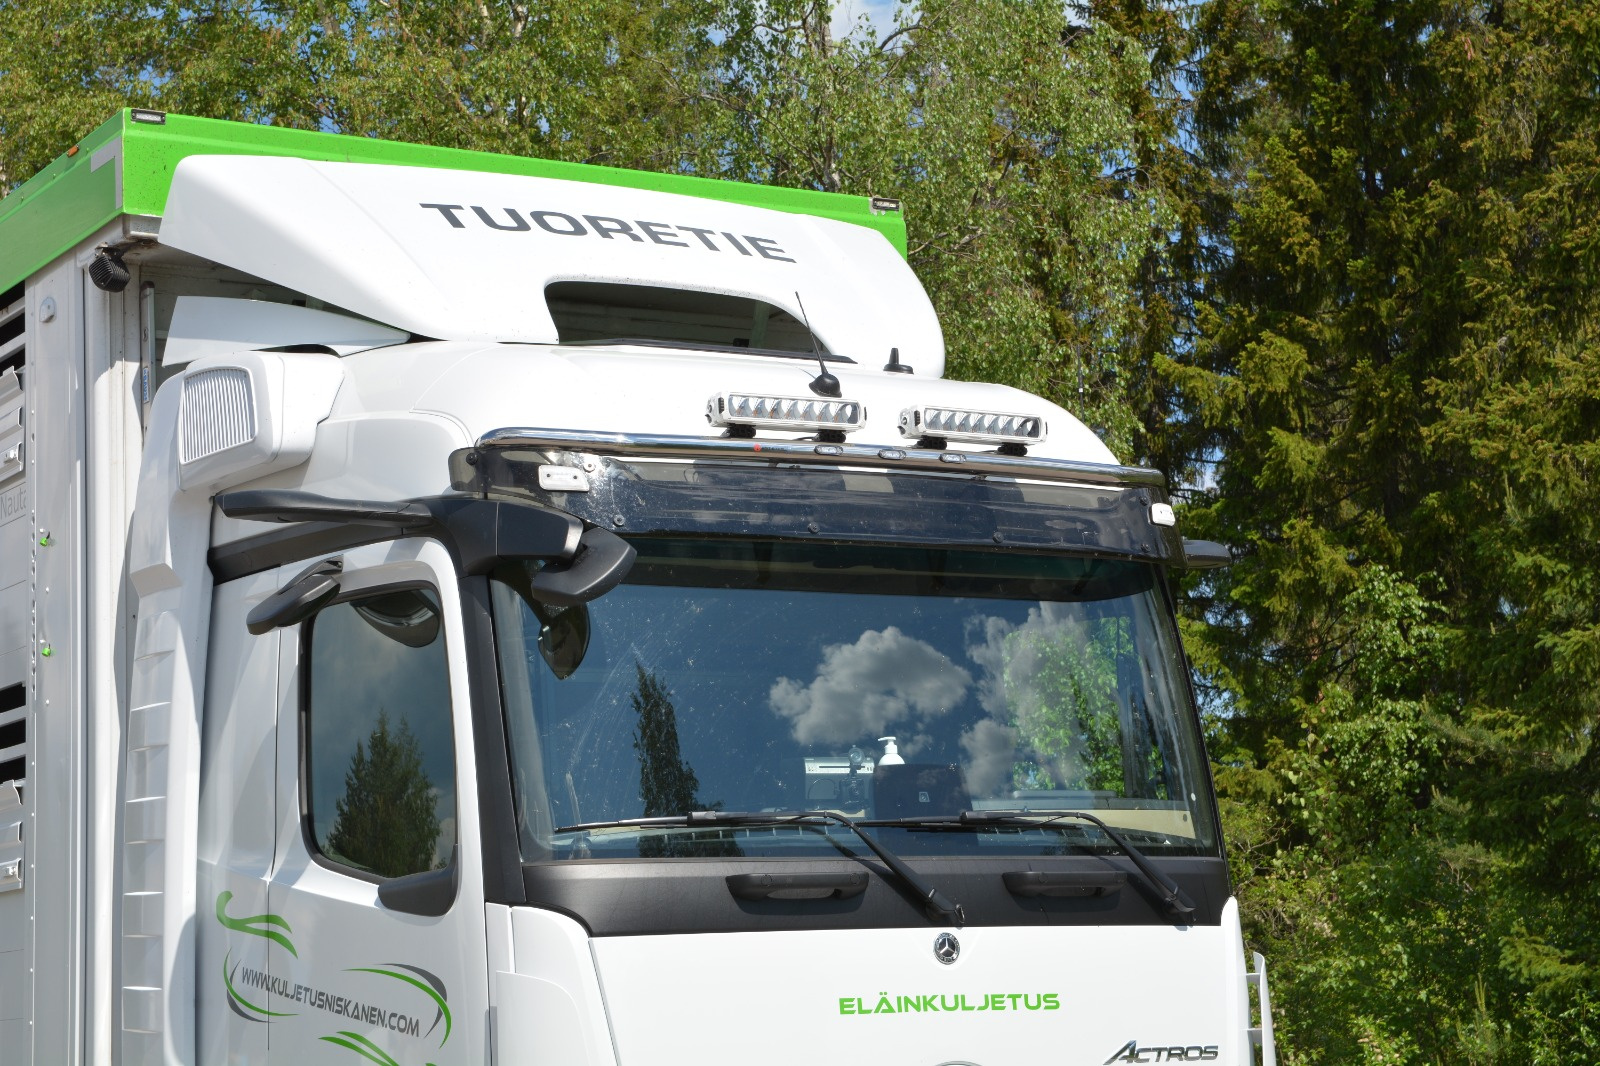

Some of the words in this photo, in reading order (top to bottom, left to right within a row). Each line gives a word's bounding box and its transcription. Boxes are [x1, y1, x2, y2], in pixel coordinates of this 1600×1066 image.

[419, 203, 796, 263] TUORETIE
[241, 966, 420, 1038] WWW.KULJETUSNISKANEN.COM
[839, 991, 1061, 1015] ELÄINKULJETUS
